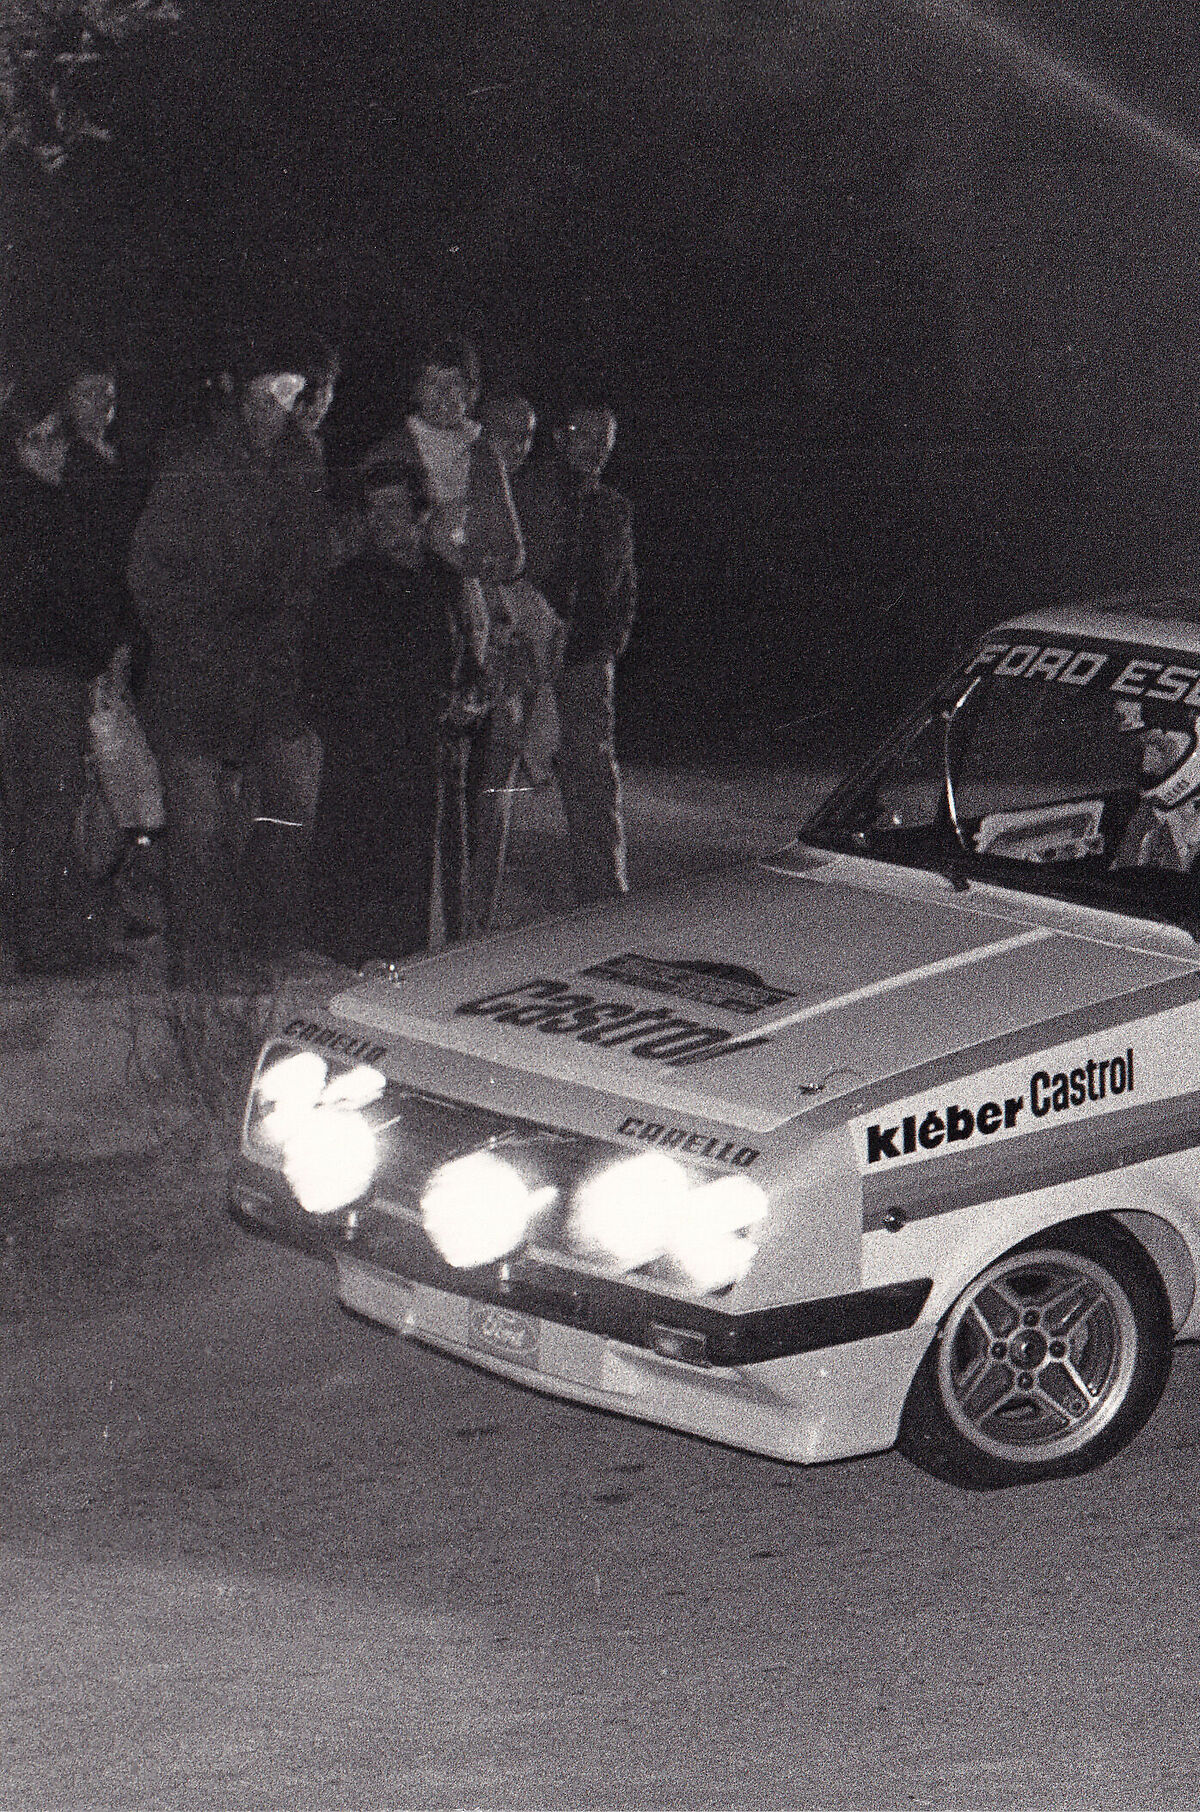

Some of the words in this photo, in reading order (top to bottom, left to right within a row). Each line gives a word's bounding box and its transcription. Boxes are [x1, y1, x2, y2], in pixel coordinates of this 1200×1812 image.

[964, 643, 1109, 686] FORD
[453, 978, 769, 1067] Castrol
[866, 1094, 1024, 1164] kléber
[1029, 1047, 1135, 1118] Castrol
[616, 1116, 761, 1168] CARELLO
